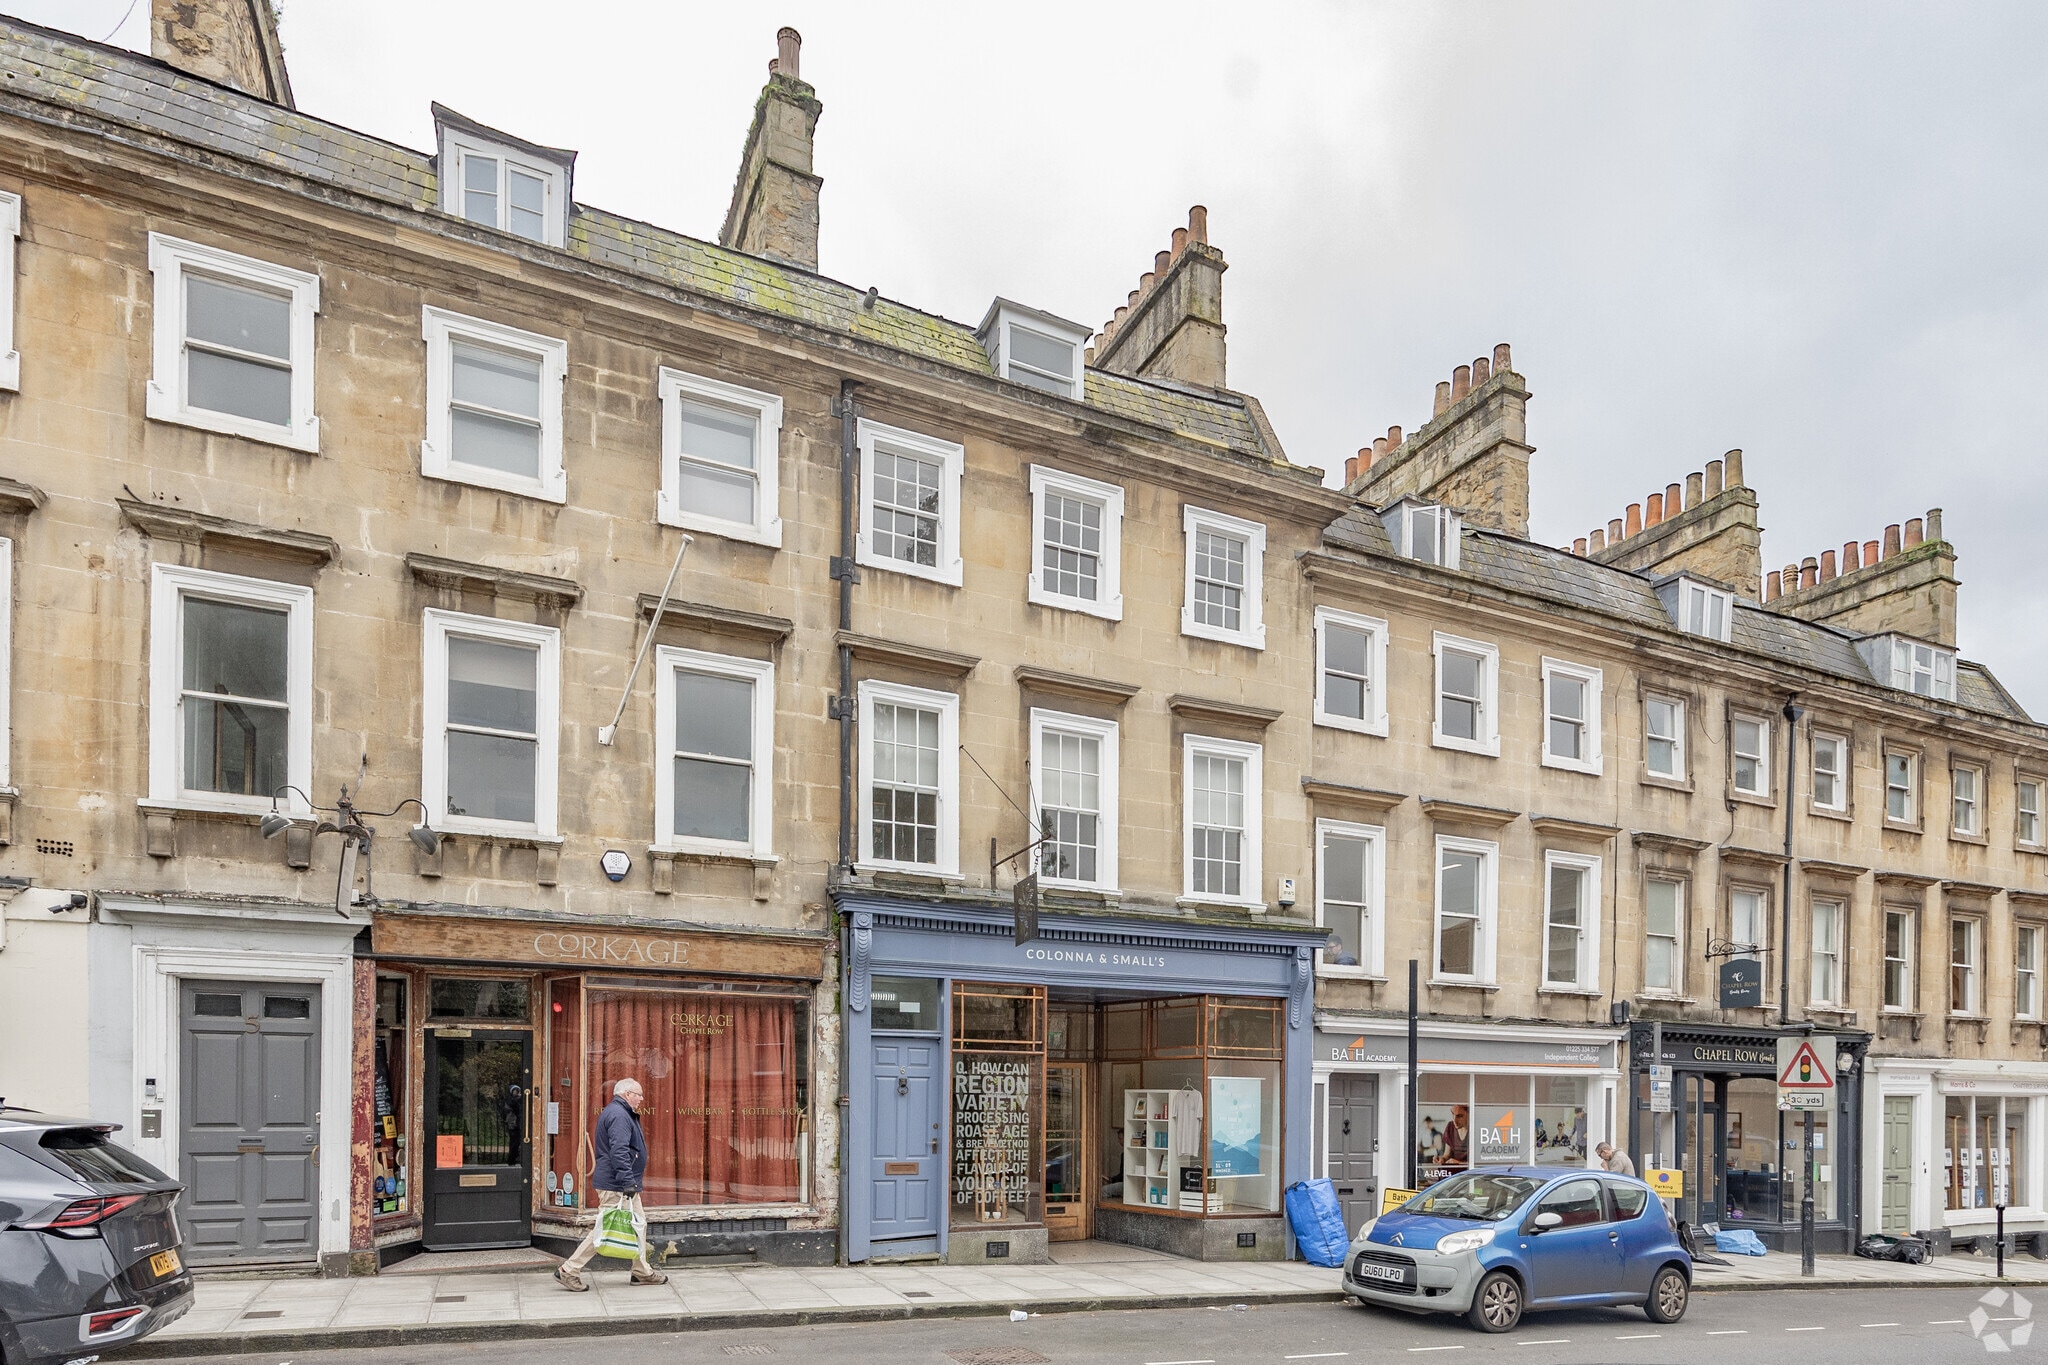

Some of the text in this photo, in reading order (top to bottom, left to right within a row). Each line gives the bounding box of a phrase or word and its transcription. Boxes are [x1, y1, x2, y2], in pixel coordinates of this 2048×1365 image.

[533, 932, 690, 964] CORKAGE
[1026, 949, 1165, 967] COLONNA & SMALL'S
[245, 1015, 260, 1034] 5
[670, 1013, 734, 1027] CORKAGE
[680, 1026, 724, 1035] CHAPEL ROW
[1331, 1045, 1398, 1062] BATH ACADEMY
[1544, 1052, 1600, 1063] Independent College
[1694, 1046, 1732, 1061] CHAPEL
[1734, 1048, 1758, 1062] ROW
[955, 1061, 1030, 1076] Q. HOW CAN
[955, 1075, 1030, 1095] REGION
[955, 1093, 1030, 1111] VARIETY
[1806, 1097, 1821, 1105] yds
[678, 1107, 723, 1116] WINE BAR
[742, 1107, 802, 1116] BOTTLE SHOP
[956, 1111, 1030, 1124] PROCESSING
[956, 1124, 1029, 1139] ROAST, AGE
[1480, 1126, 1521, 1145] BATH
[956, 1139, 1029, 1149] & BREW METHOD
[1480, 1145, 1520, 1154] ACADEMY
[955, 1149, 1030, 1161] AFFECT THE
[957, 1162, 1029, 1175] FLAVOUR OF
[955, 1175, 1030, 1191] YOUR CUP
[956, 1190, 1031, 1204] OF COFFEE?
[1392, 1193, 1407, 1201] Bath
[1364, 1265, 1400, 1280] GU60 LPO
